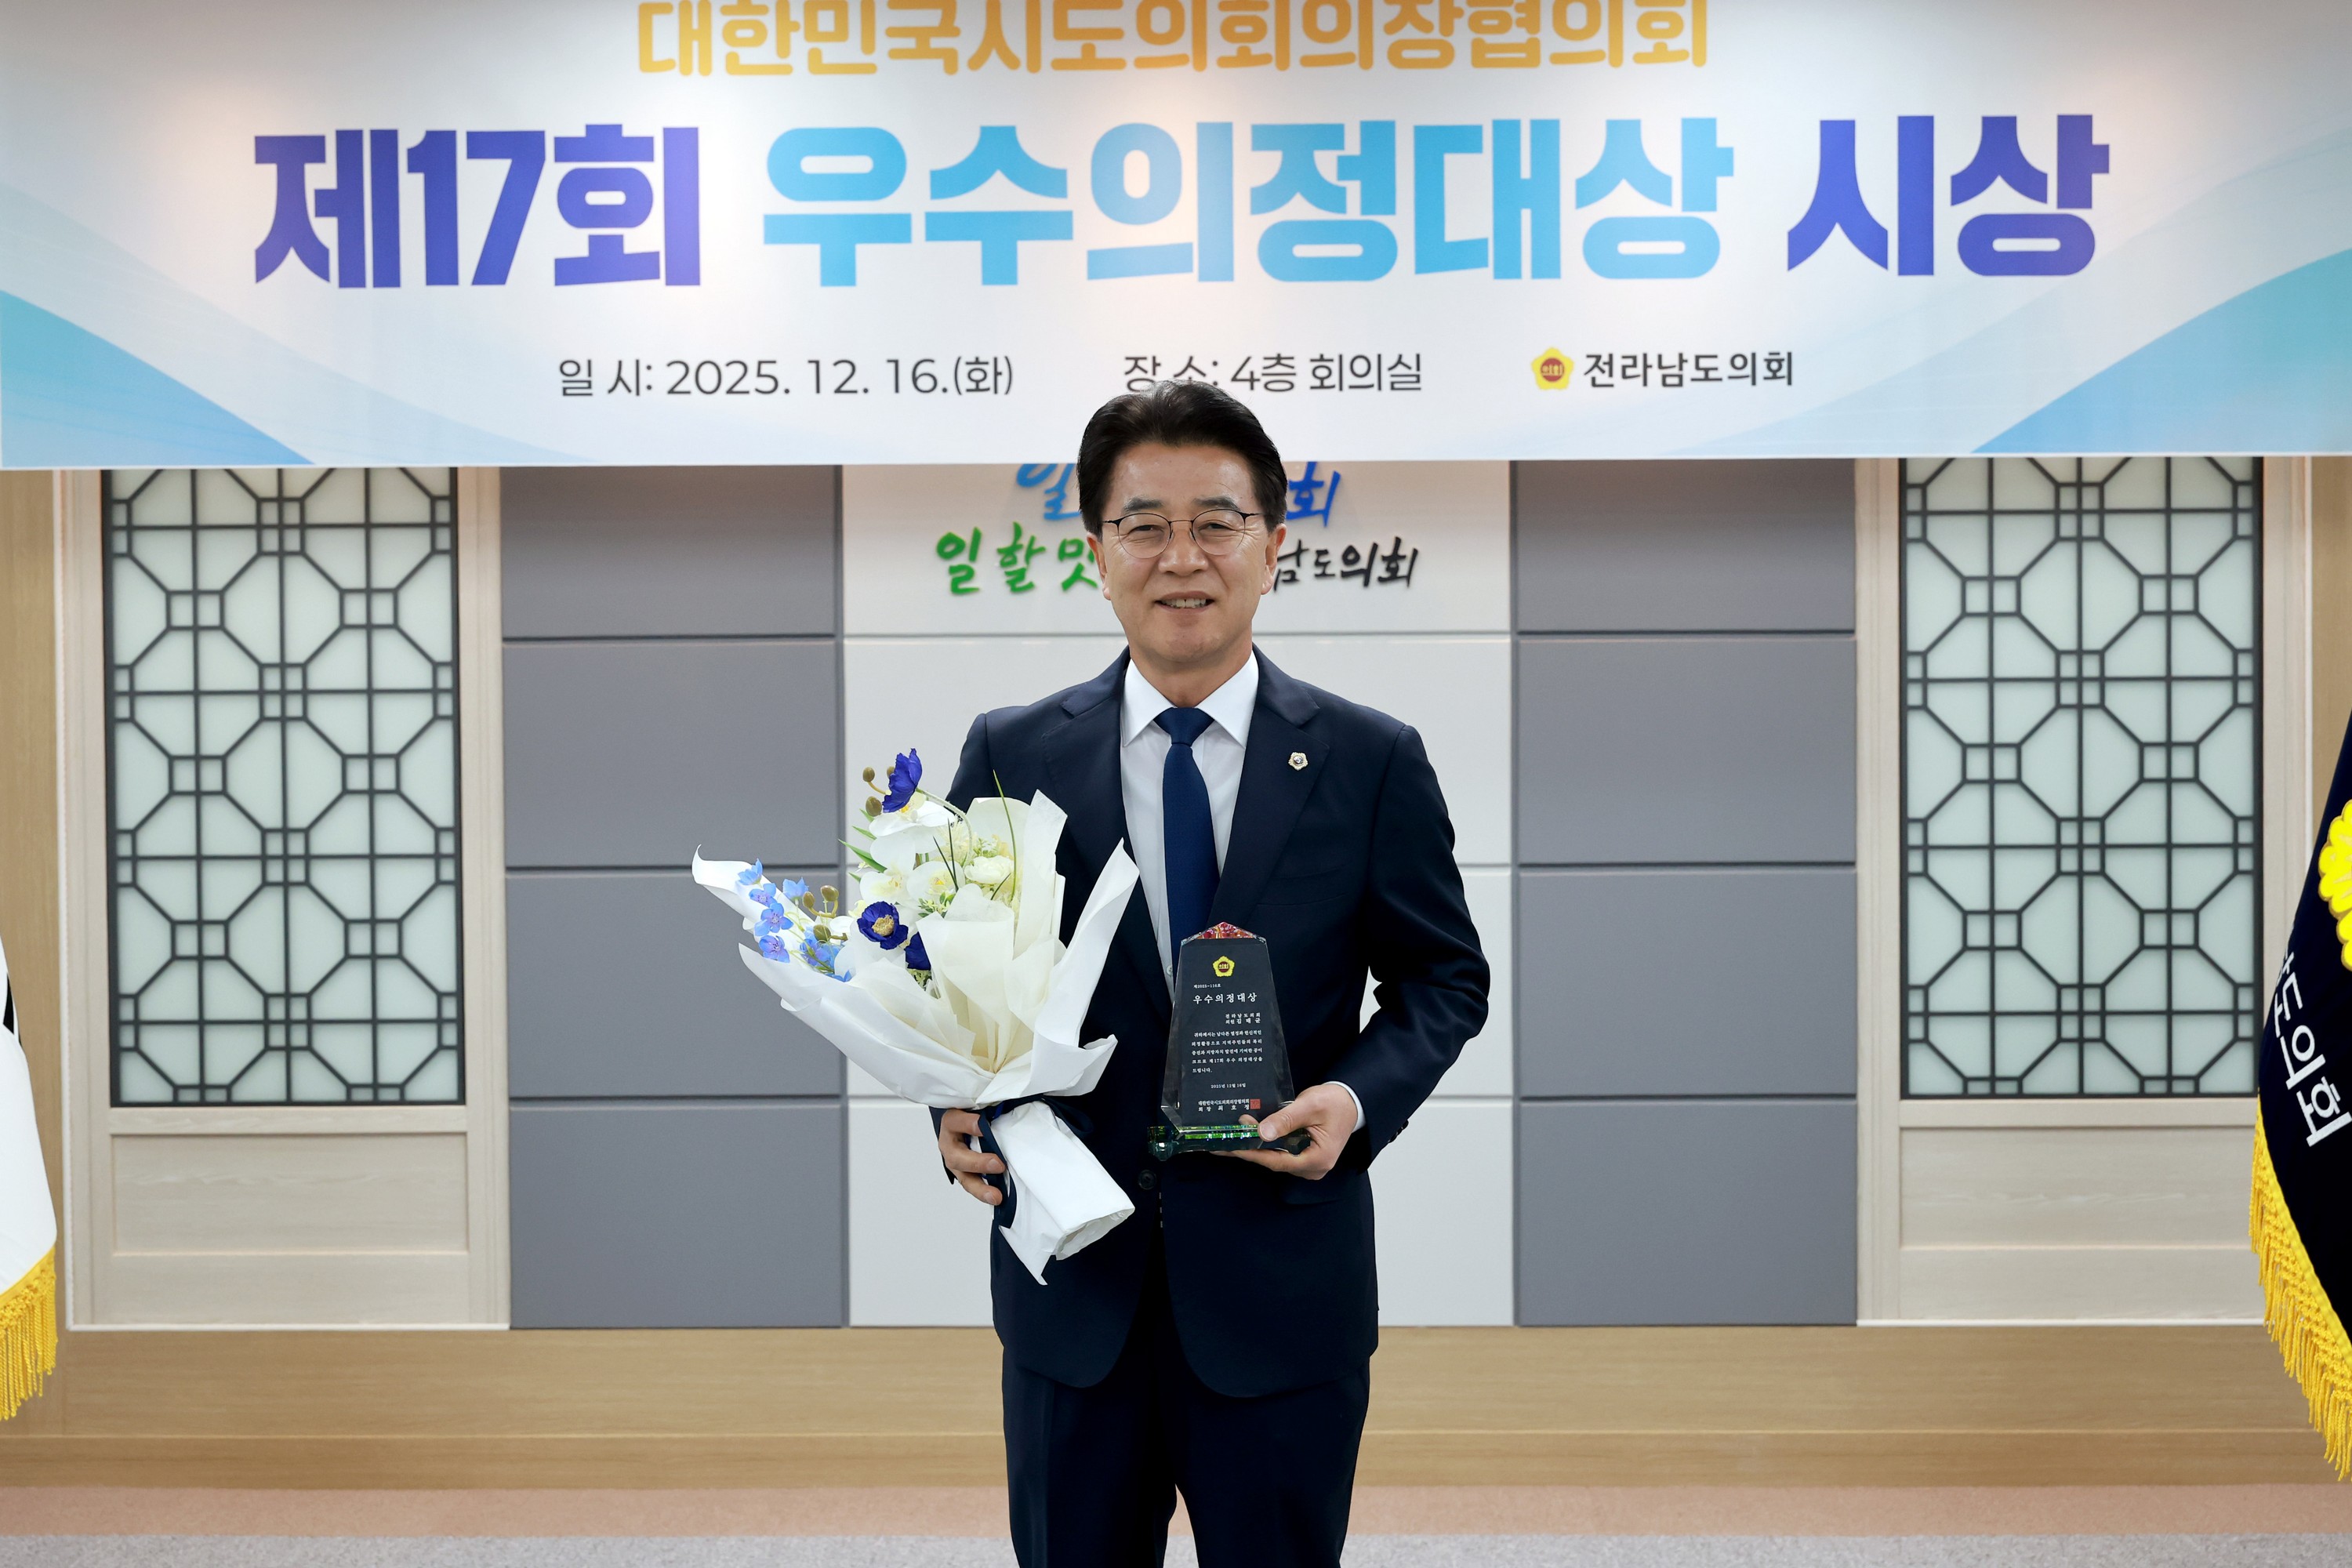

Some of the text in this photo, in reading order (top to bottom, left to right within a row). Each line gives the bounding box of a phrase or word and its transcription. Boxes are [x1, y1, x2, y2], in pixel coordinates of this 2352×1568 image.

[255, 114, 2109, 288] 제17회 우수의정대상 시상
[559, 356, 1013, 396] 일 시: 2025. 12. 16.(화)
[1123, 355, 1161, 393] 장
[1231, 354, 1297, 392] 4층
[1310, 354, 1421, 392] 회의실
[1584, 352, 1793, 387] 전라남도의회
[1193, 993, 1257, 1004] 우수의정대상
